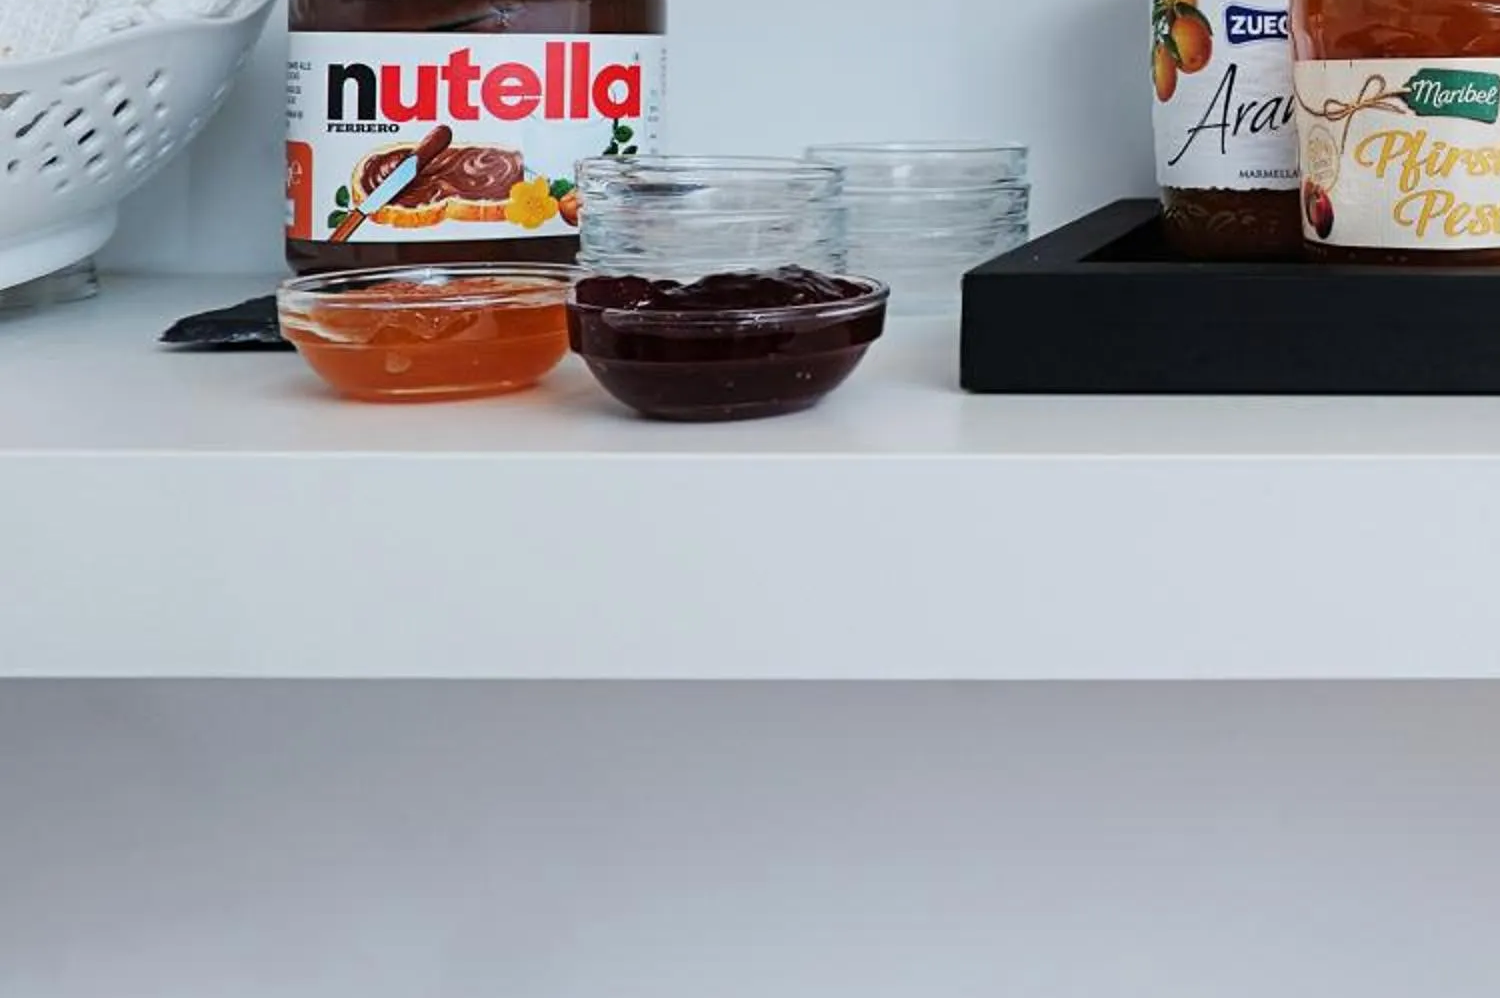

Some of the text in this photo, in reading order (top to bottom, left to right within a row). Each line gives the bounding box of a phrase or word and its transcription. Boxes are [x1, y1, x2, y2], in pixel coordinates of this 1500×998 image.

[327, 41, 641, 123] nutella
[1412, 79, 1499, 108] Maribel
[326, 122, 401, 134] FERRERO
